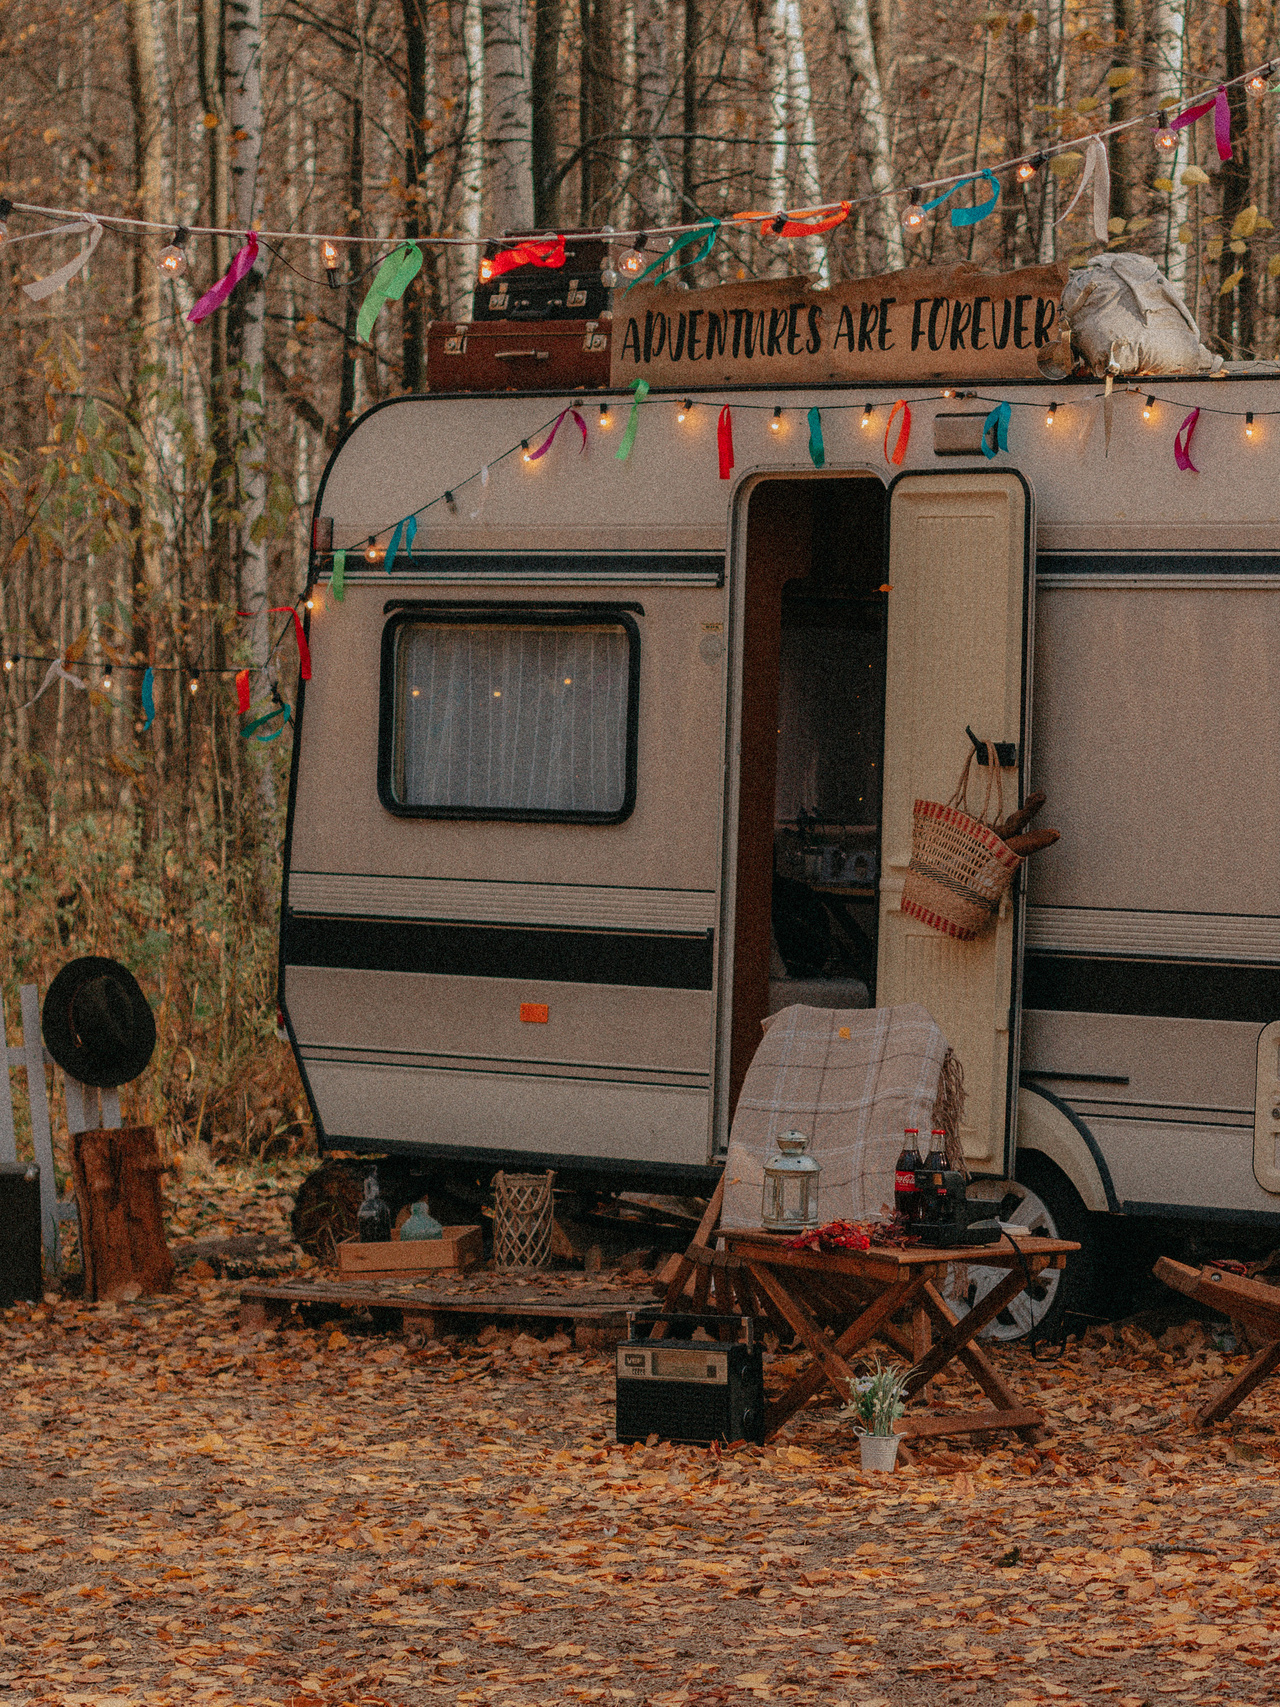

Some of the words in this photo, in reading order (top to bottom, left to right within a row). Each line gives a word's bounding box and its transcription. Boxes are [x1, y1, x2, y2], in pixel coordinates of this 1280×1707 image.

[621, 302, 824, 364] ADVENTURES
[833, 297, 897, 353] ARE
[911, 294, 1058, 352] FOREVER
